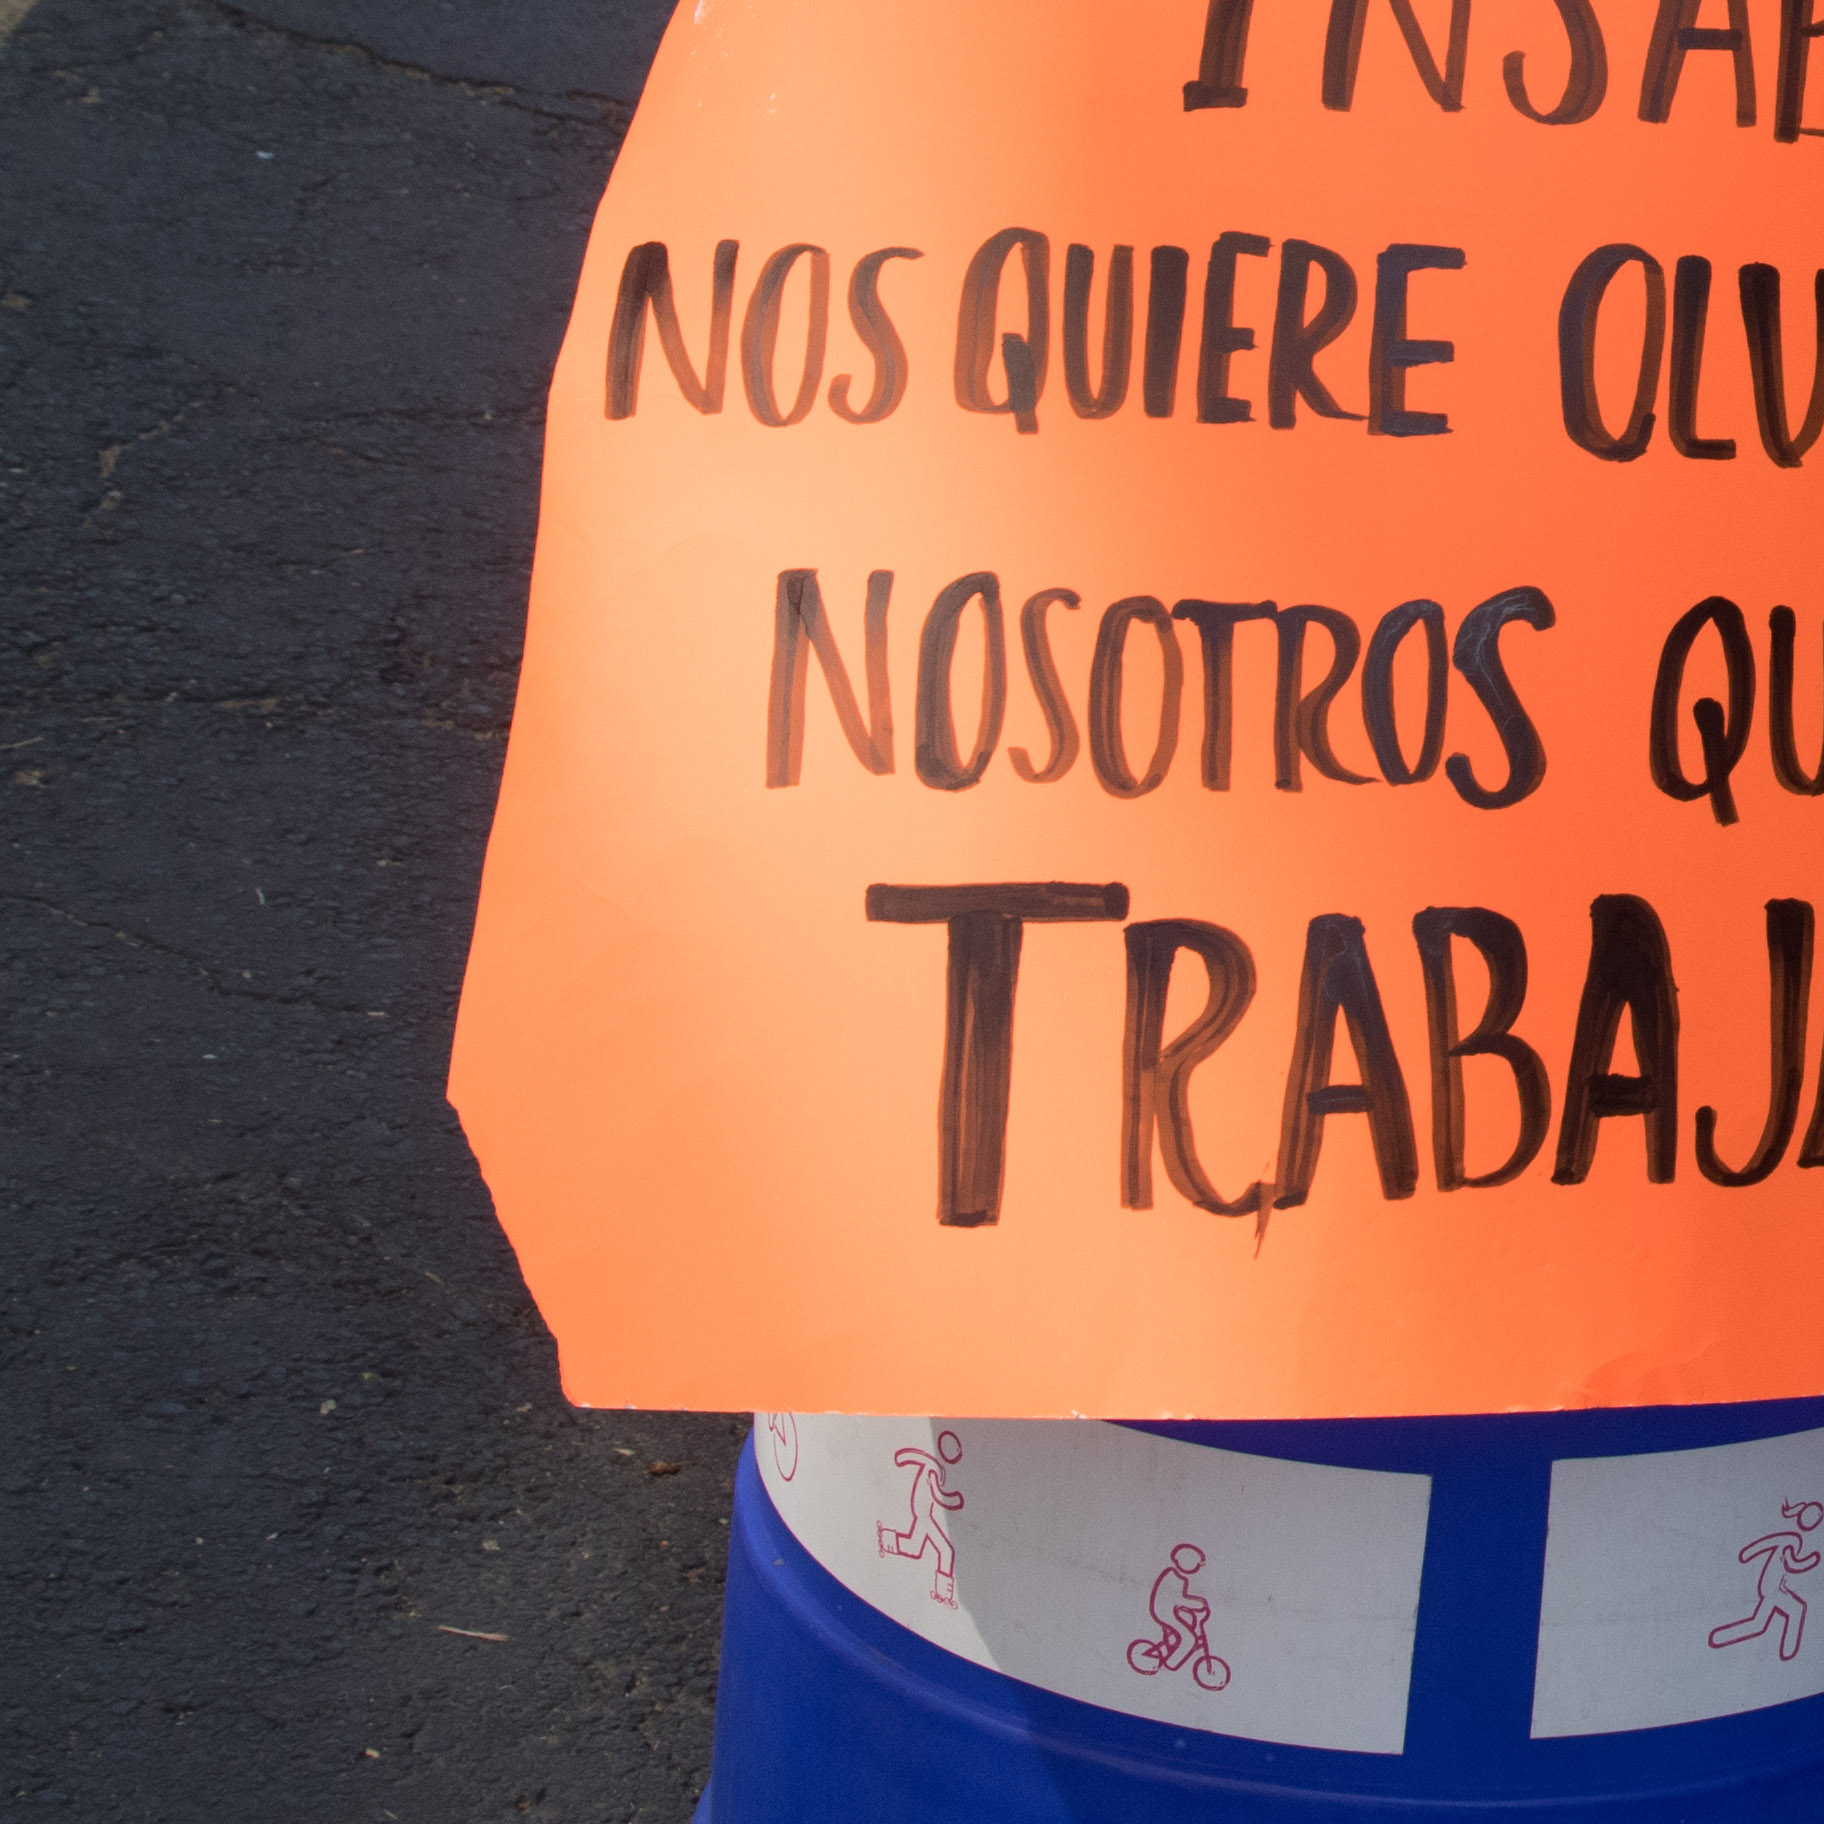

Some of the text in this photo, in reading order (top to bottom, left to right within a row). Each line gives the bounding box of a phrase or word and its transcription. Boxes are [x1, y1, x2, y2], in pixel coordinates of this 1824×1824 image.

[604, 236, 922, 430] NOS
[953, 225, 1468, 438] QUIERE
[763, 565, 1556, 811] NOSOTROS
